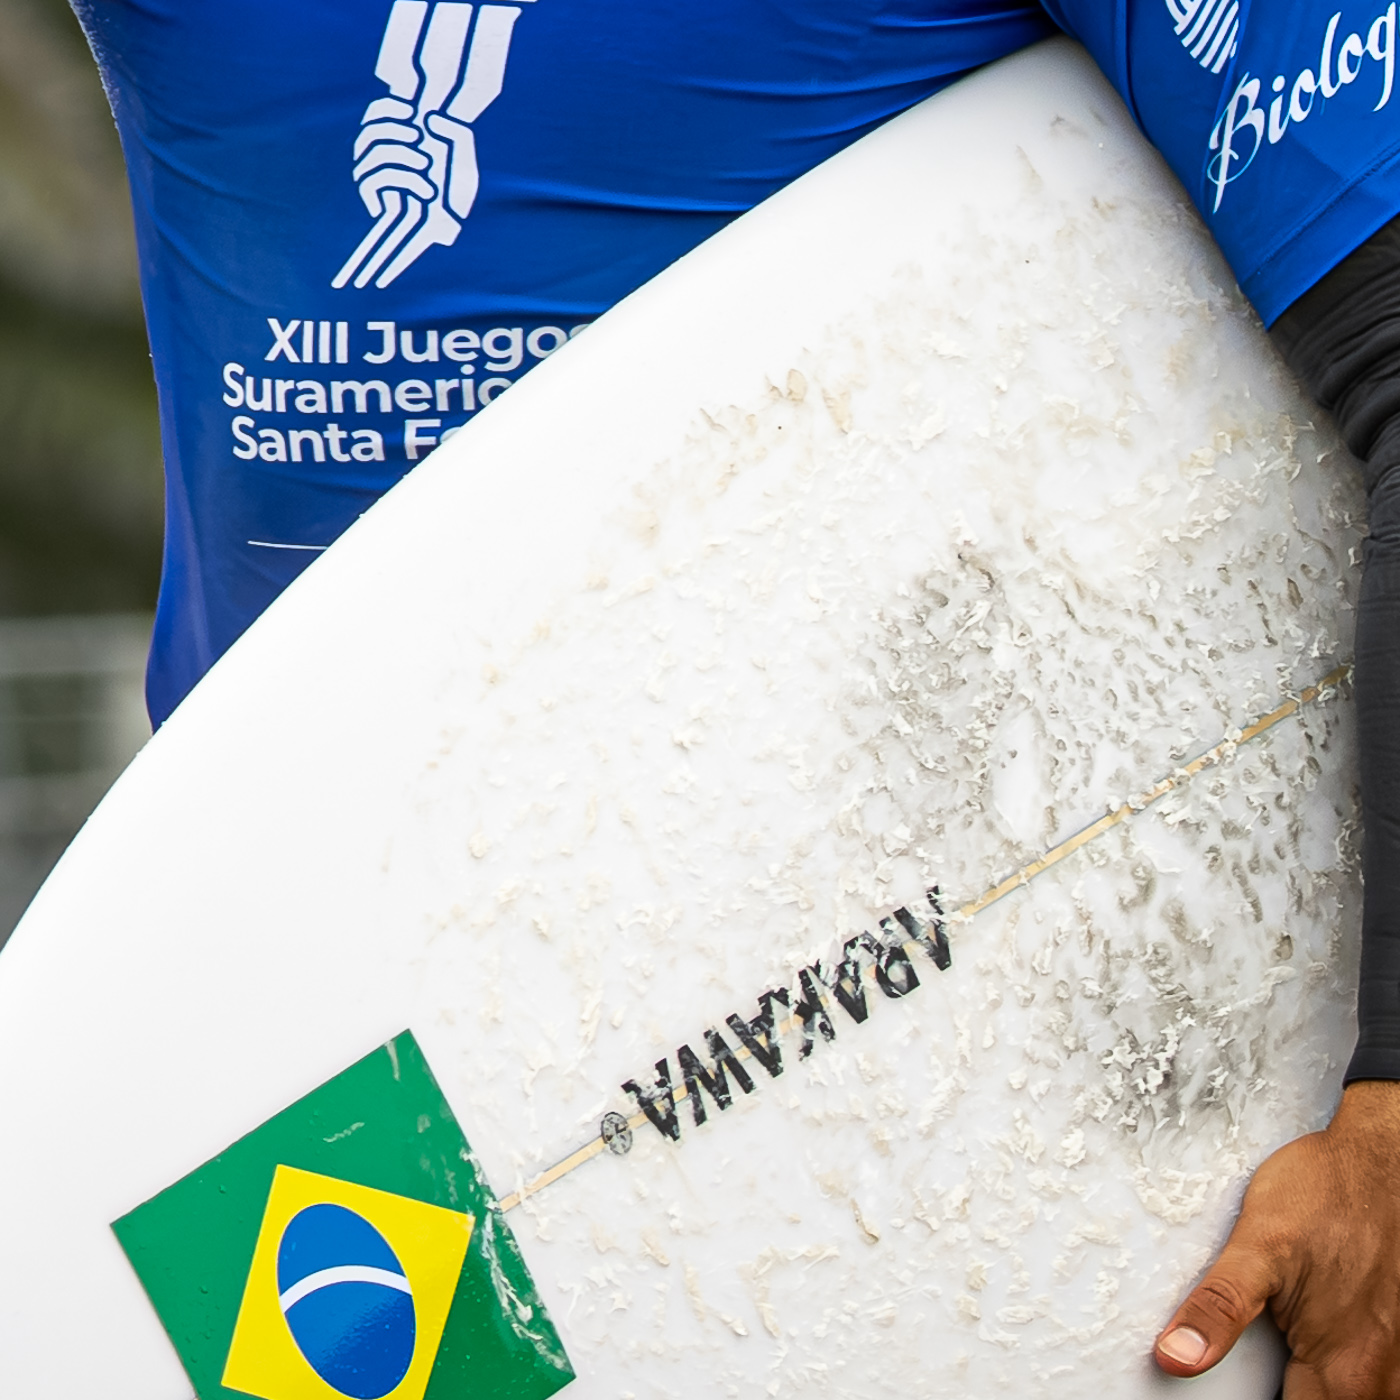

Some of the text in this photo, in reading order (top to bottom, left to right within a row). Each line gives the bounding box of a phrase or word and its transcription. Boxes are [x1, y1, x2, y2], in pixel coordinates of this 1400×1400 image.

[264, 317, 349, 364] XIII
[231, 415, 463, 463] Santa F
[620, 884, 953, 1141] ARAKAWA
